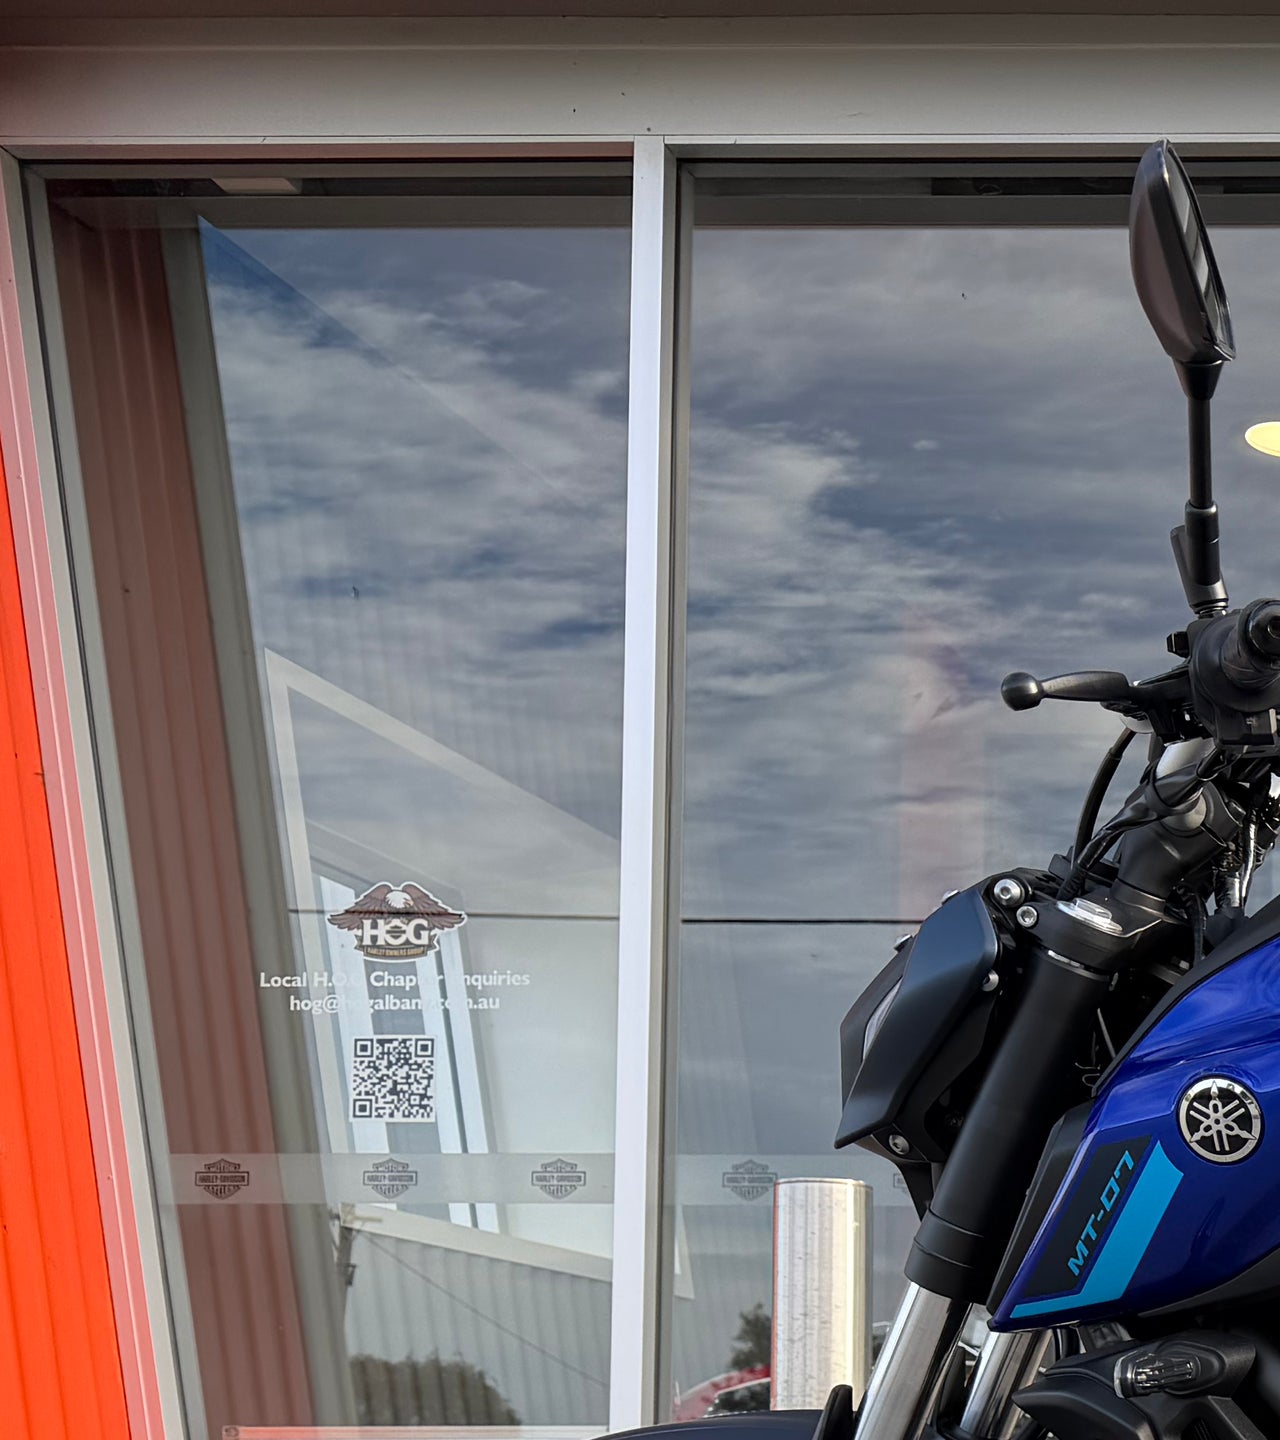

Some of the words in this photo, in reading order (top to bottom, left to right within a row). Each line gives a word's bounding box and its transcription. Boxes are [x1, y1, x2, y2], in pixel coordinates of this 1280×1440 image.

[362, 918, 430, 946] HOG
[259, 971, 307, 988] Local
[455, 971, 531, 991] nquiries
[1066, 1149, 1136, 1278] MT-07
